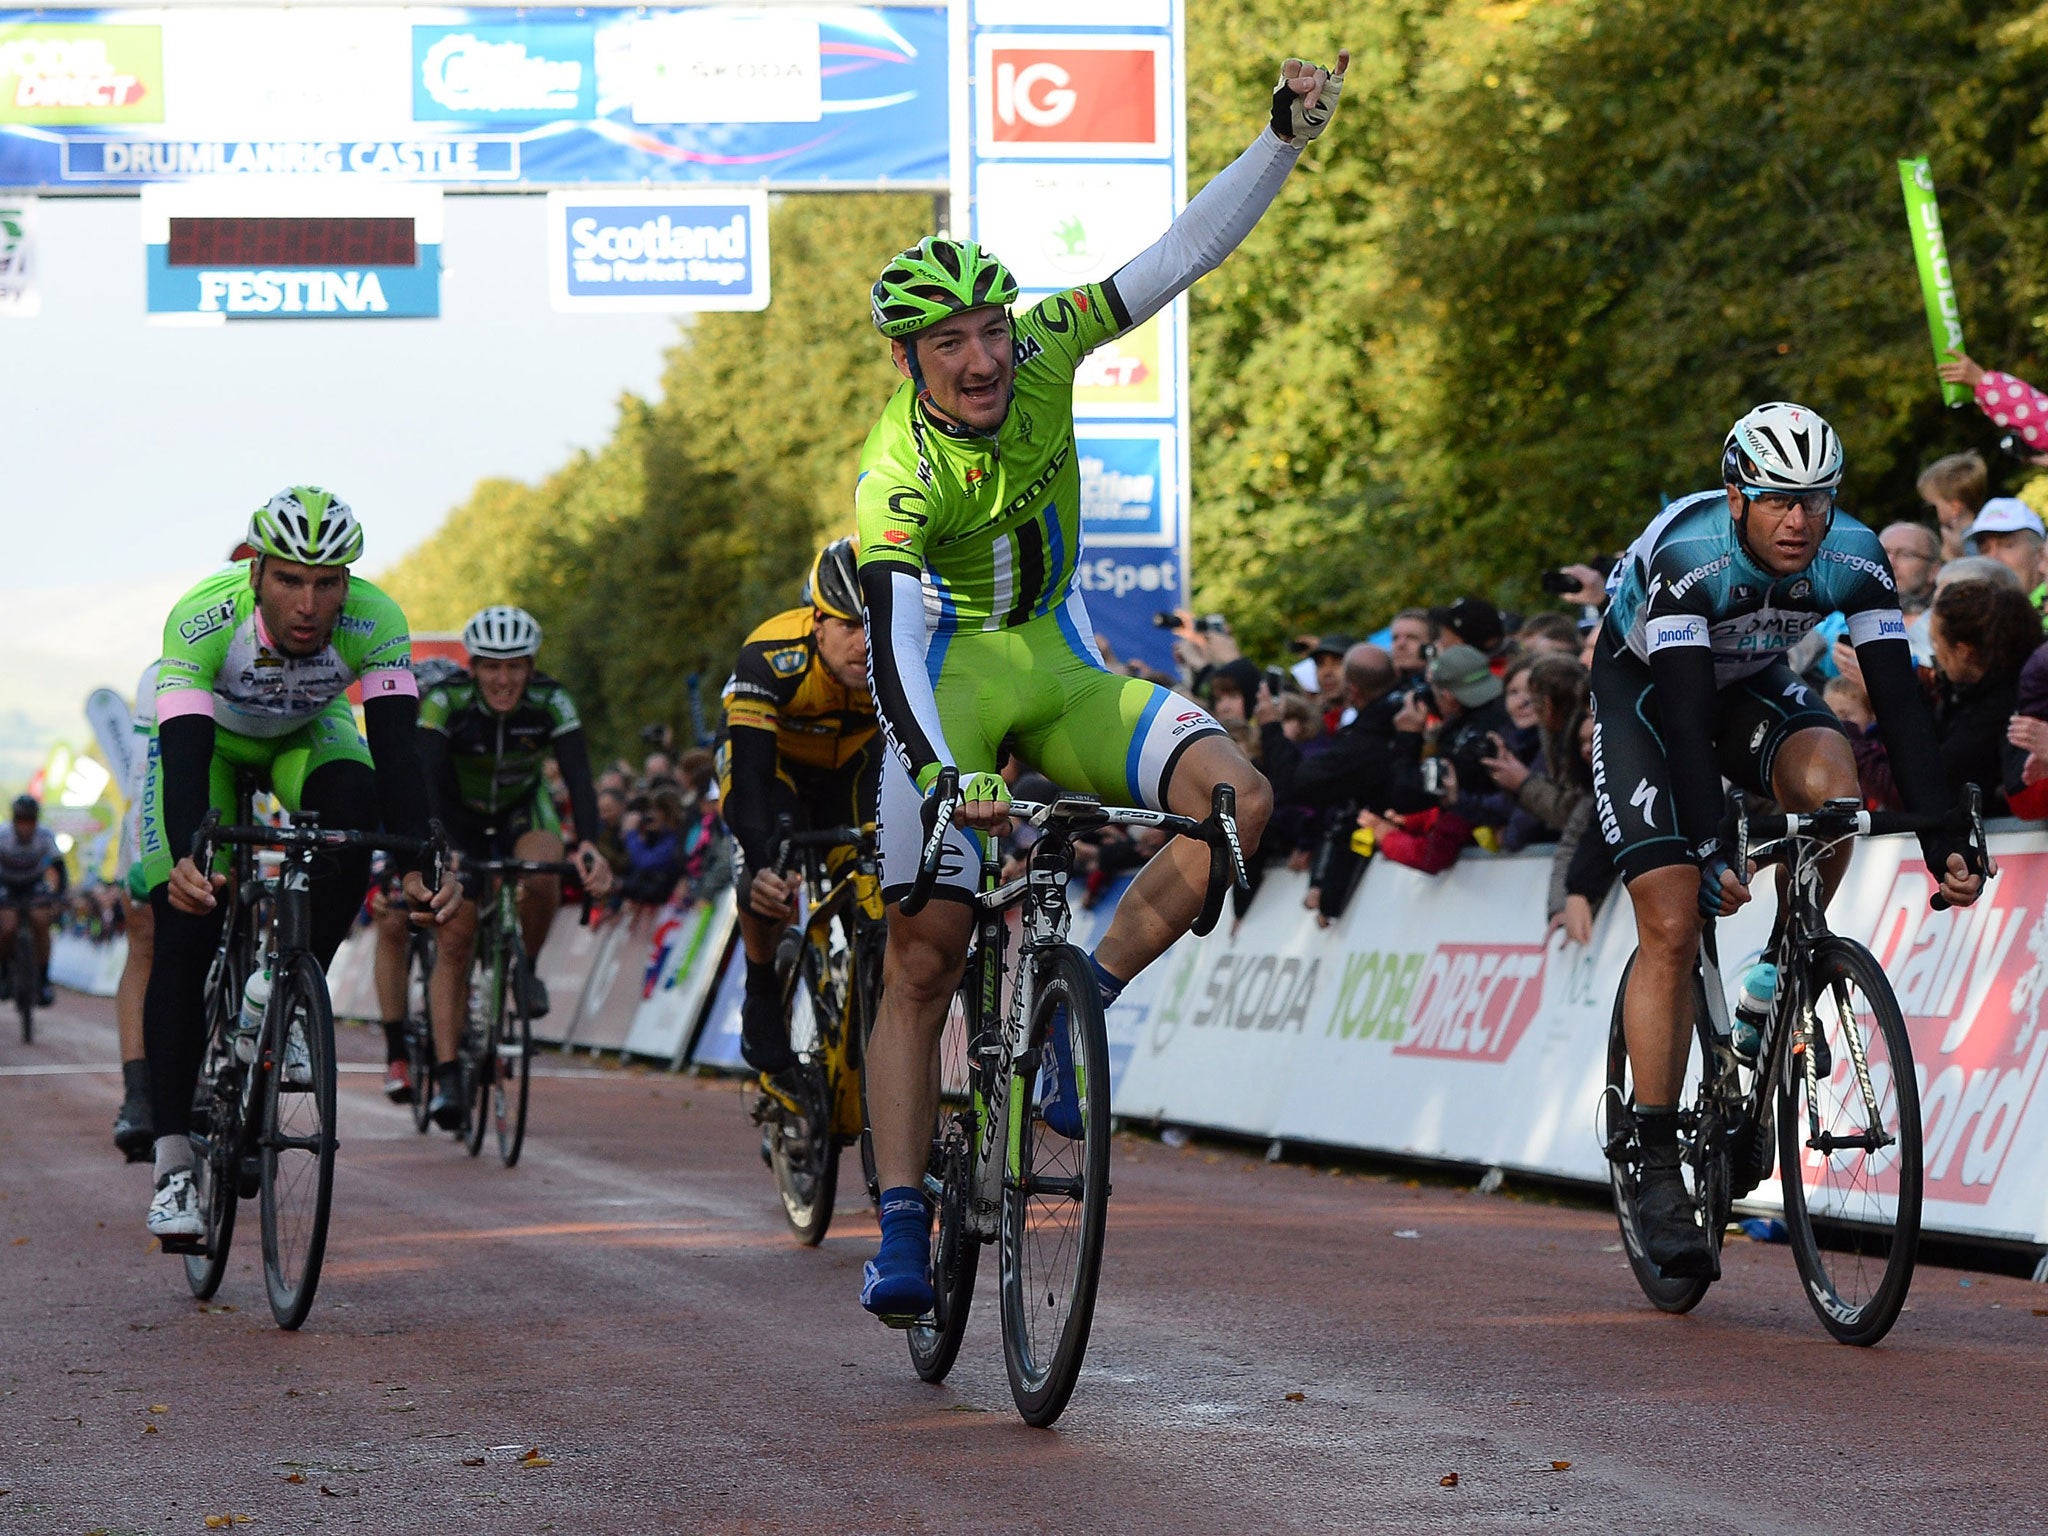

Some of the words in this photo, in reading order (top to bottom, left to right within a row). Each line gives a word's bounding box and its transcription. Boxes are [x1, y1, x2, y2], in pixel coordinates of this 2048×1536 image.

[998, 62, 1077, 127] IG
[103, 143, 342, 173] DRUMLANRIG
[349, 143, 478, 173] CASTLE
[572, 214, 746, 260] Scotland
[198, 271, 388, 312] FESTINA
[916, 268, 944, 283] RUDY
[890, 317, 927, 334] RUDY
[180, 606, 220, 640] CSF
[863, 606, 912, 772] cannondale
[1191, 954, 1320, 1034] SKODA
[1325, 950, 1427, 1041] YODEL
[1400, 952, 1540, 1054] DIRECT
